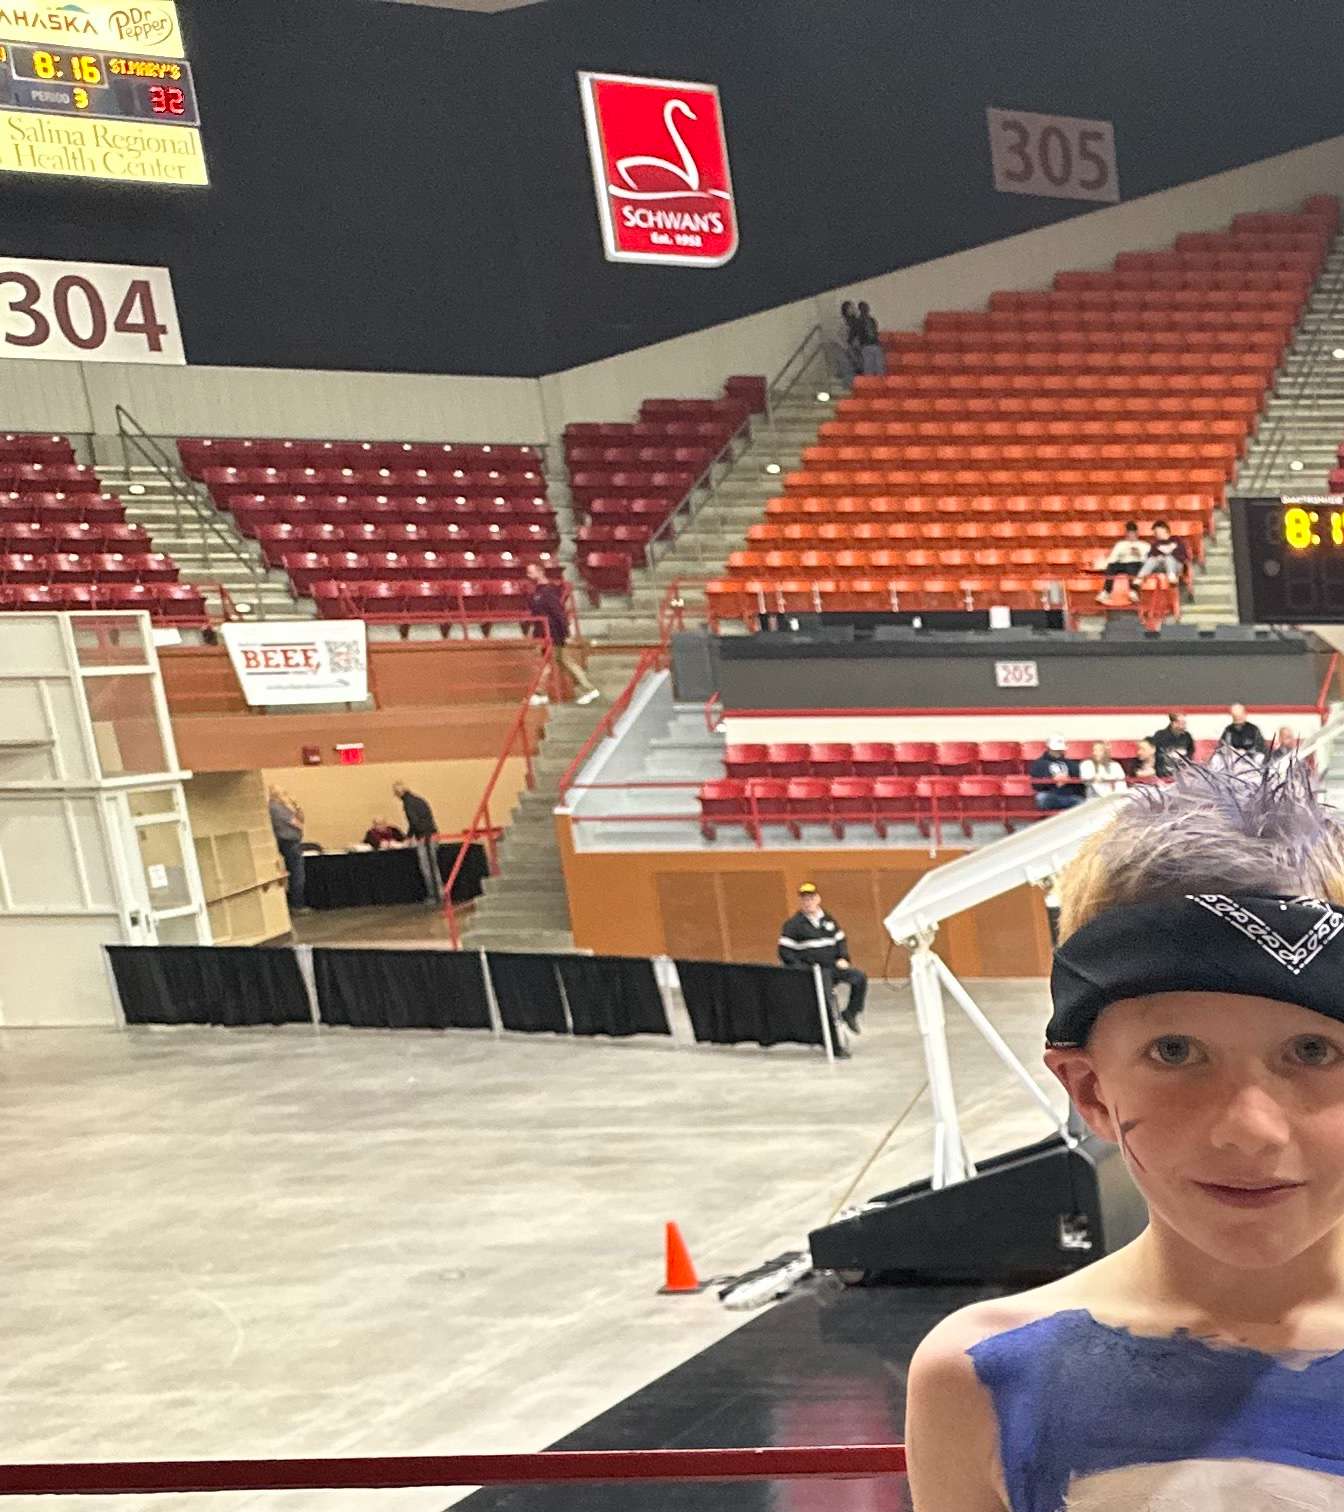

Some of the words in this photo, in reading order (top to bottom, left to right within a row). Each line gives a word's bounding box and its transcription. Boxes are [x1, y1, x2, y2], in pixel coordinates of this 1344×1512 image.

[0, 9, 98, 35] AHASKA
[113, 10, 168, 40] Pepper
[130, 7, 152, 24] Dr
[32, 51, 100, 84] 8:16
[72, 87, 89, 109] 3
[150, 85, 185, 115] 32
[8, 116, 86, 147] Salina
[93, 124, 197, 157] Regional
[14, 143, 96, 172] Health
[103, 151, 186, 179] Center
[1001, 120, 1109, 190] 305
[621, 205, 724, 234] SCHWAN'S
[0, 271, 168, 352] 304
